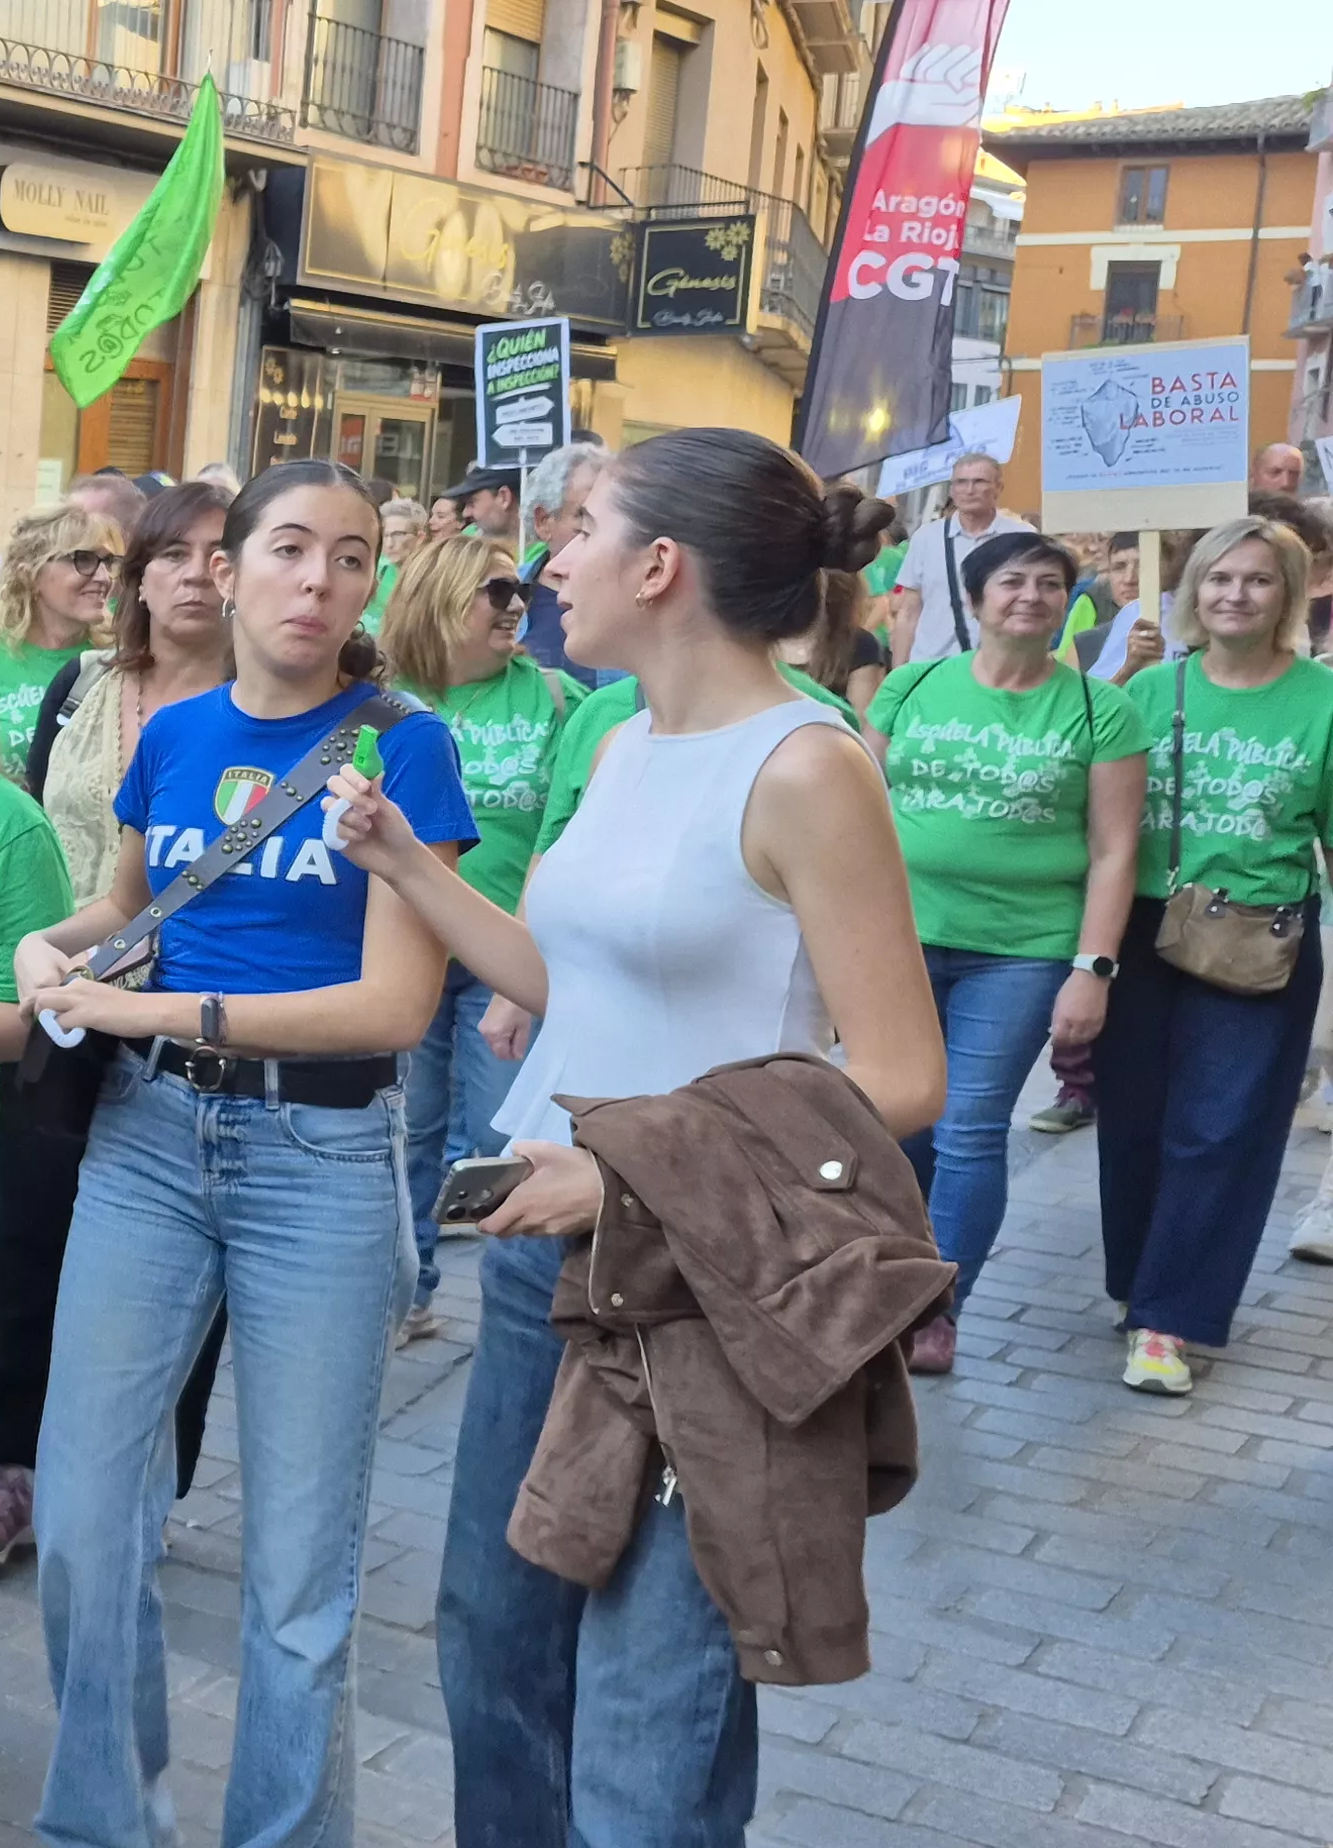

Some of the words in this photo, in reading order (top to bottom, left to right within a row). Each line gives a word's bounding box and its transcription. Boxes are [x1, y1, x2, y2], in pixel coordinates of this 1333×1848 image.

[14, 178, 66, 209] MOLLY
[73, 189, 110, 217] NAIL
[899, 220, 961, 252] Rioj
[847, 250, 961, 307] CGT
[486, 328, 547, 364] ¿QUIÉN
[487, 346, 560, 380] INSPECCIONA
[1150, 371, 1238, 395] BASTA
[1150, 395, 1171, 410] DE
[1180, 390, 1240, 407] ABUSO
[1118, 405, 1240, 430] LABORAL
[225, 769, 270, 785] ITALIA
[910, 758, 948, 778] DE
